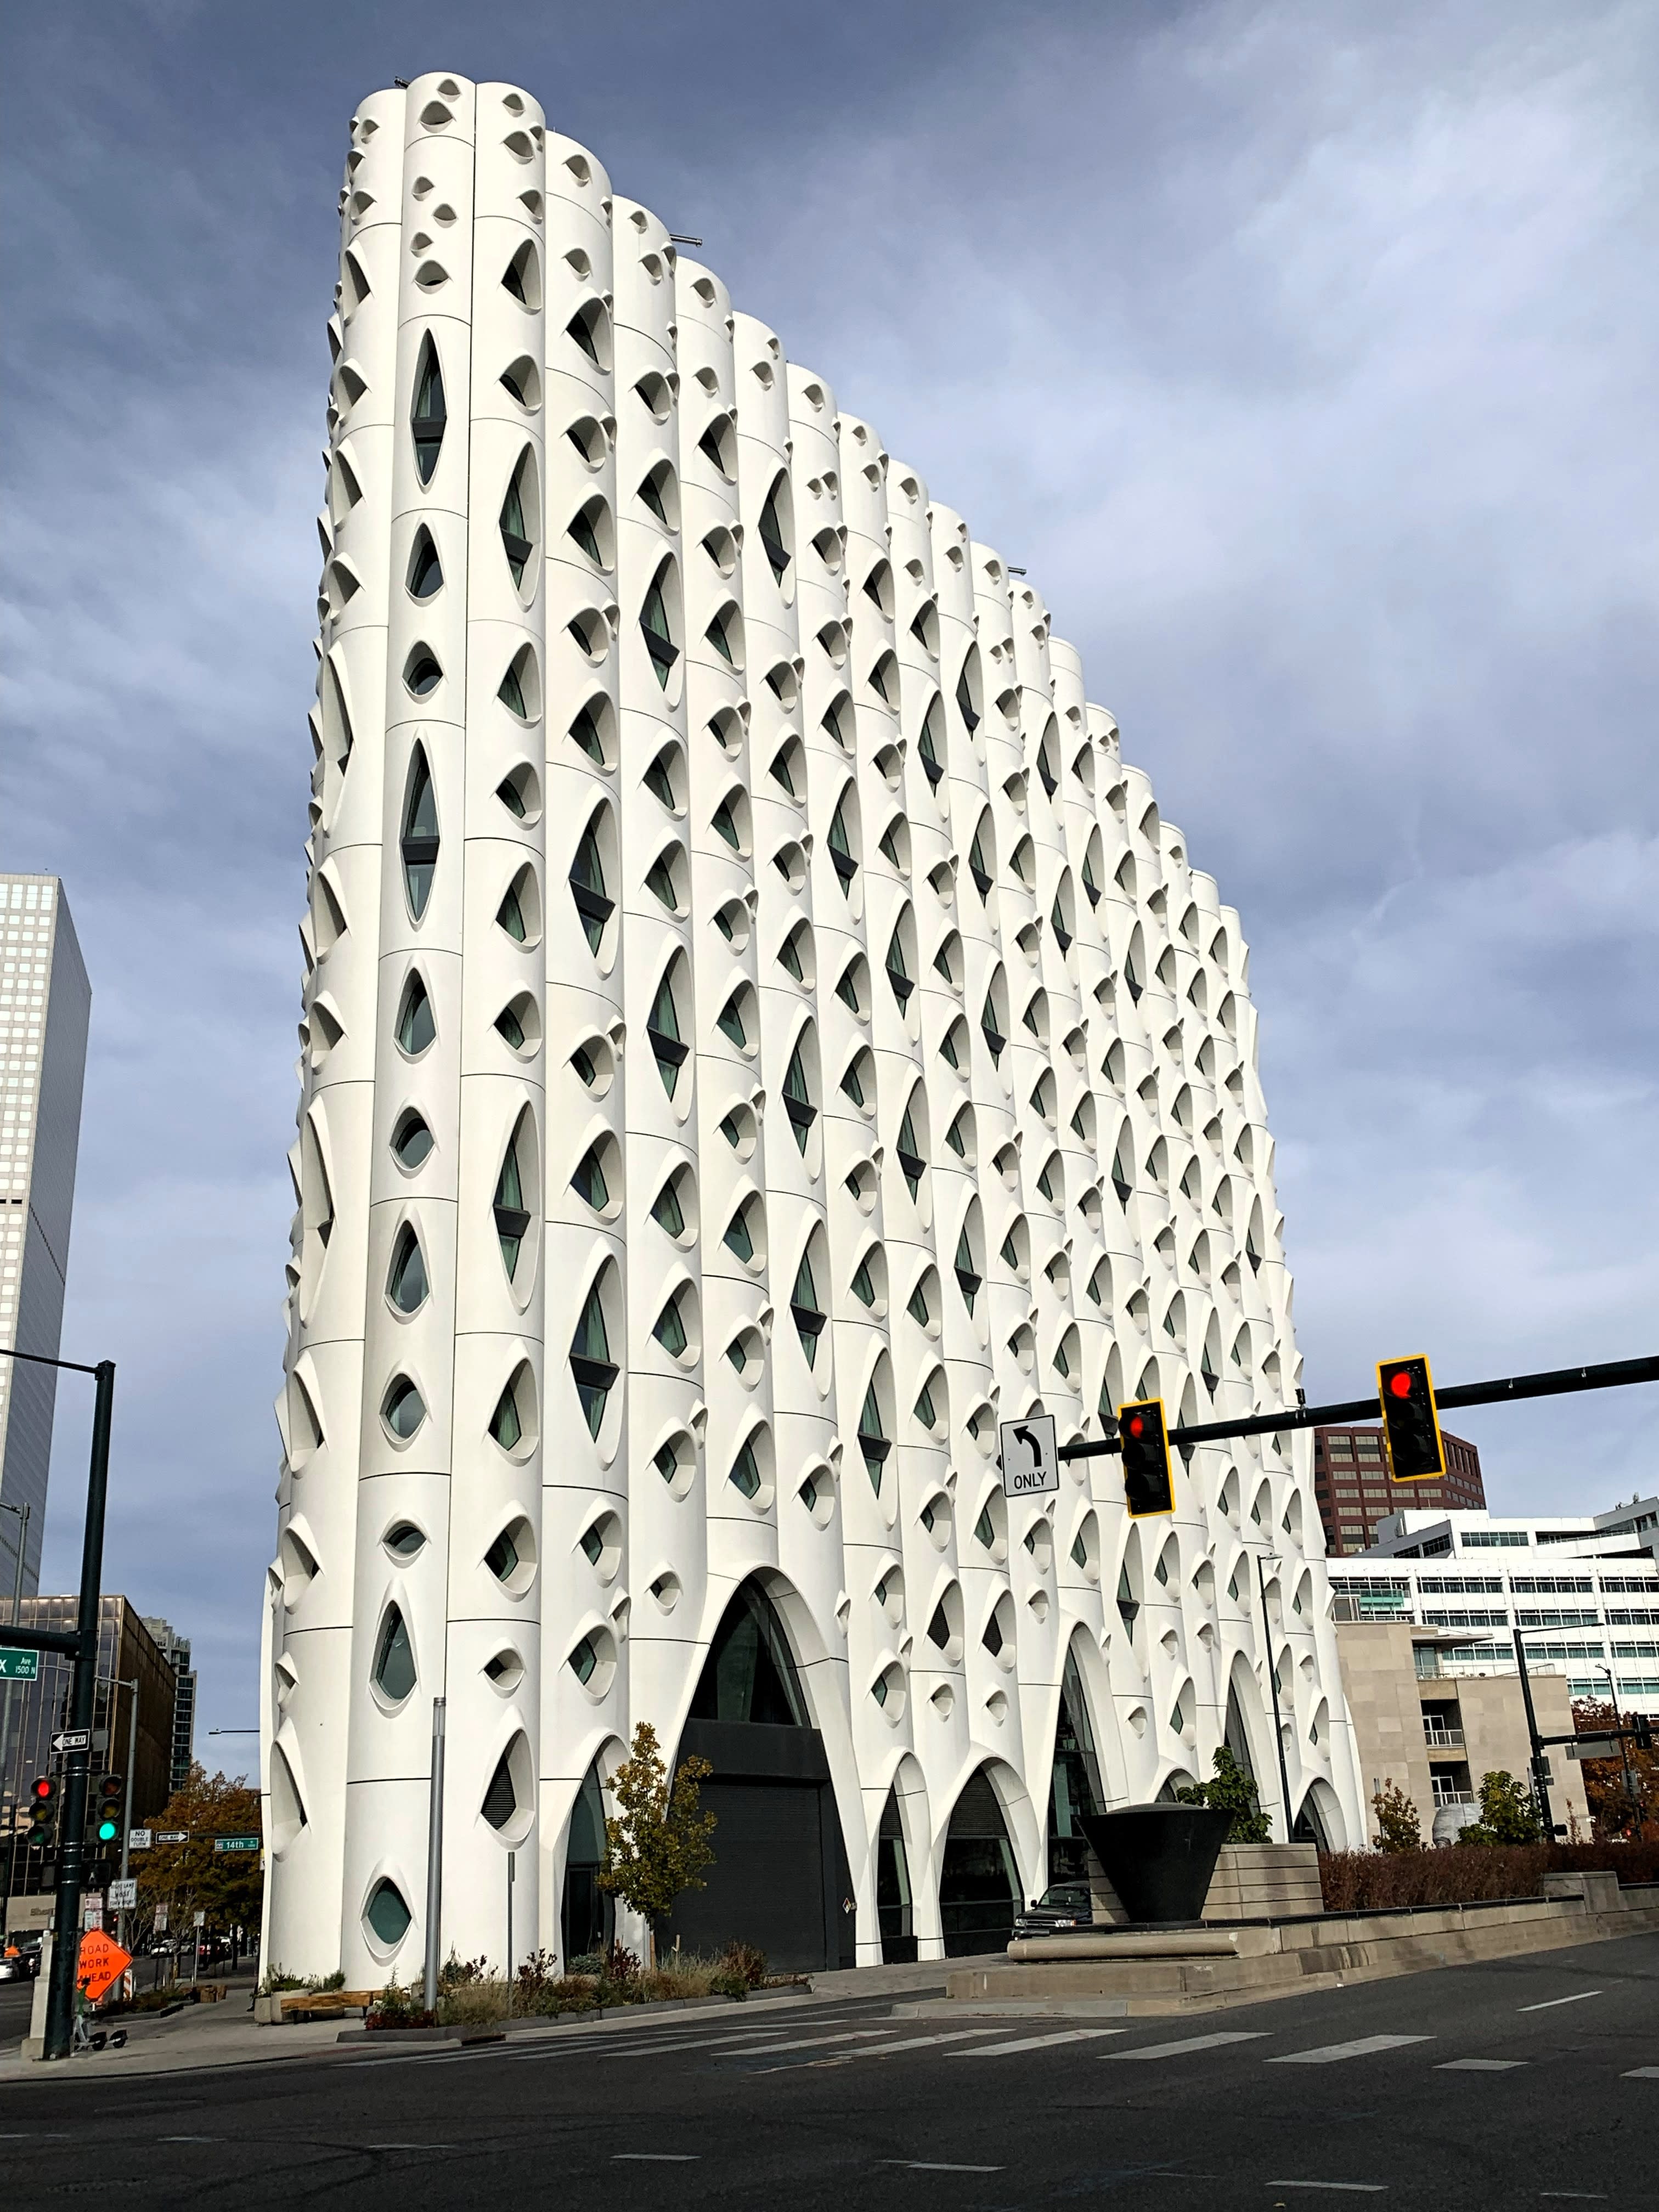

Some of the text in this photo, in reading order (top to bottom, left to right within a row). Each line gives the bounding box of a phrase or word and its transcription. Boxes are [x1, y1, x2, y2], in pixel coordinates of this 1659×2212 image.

[1014, 1471, 1047, 1489] ONLY
[20, 1657, 31, 1666] Ave
[15, 1665, 36, 1674] 1500 N
[62, 1736, 86, 1746] ONE WAY
[226, 1841, 244, 1849] 14th
[80, 1943, 109, 1955] ROAD
[79, 1957, 109, 1970] WORK
